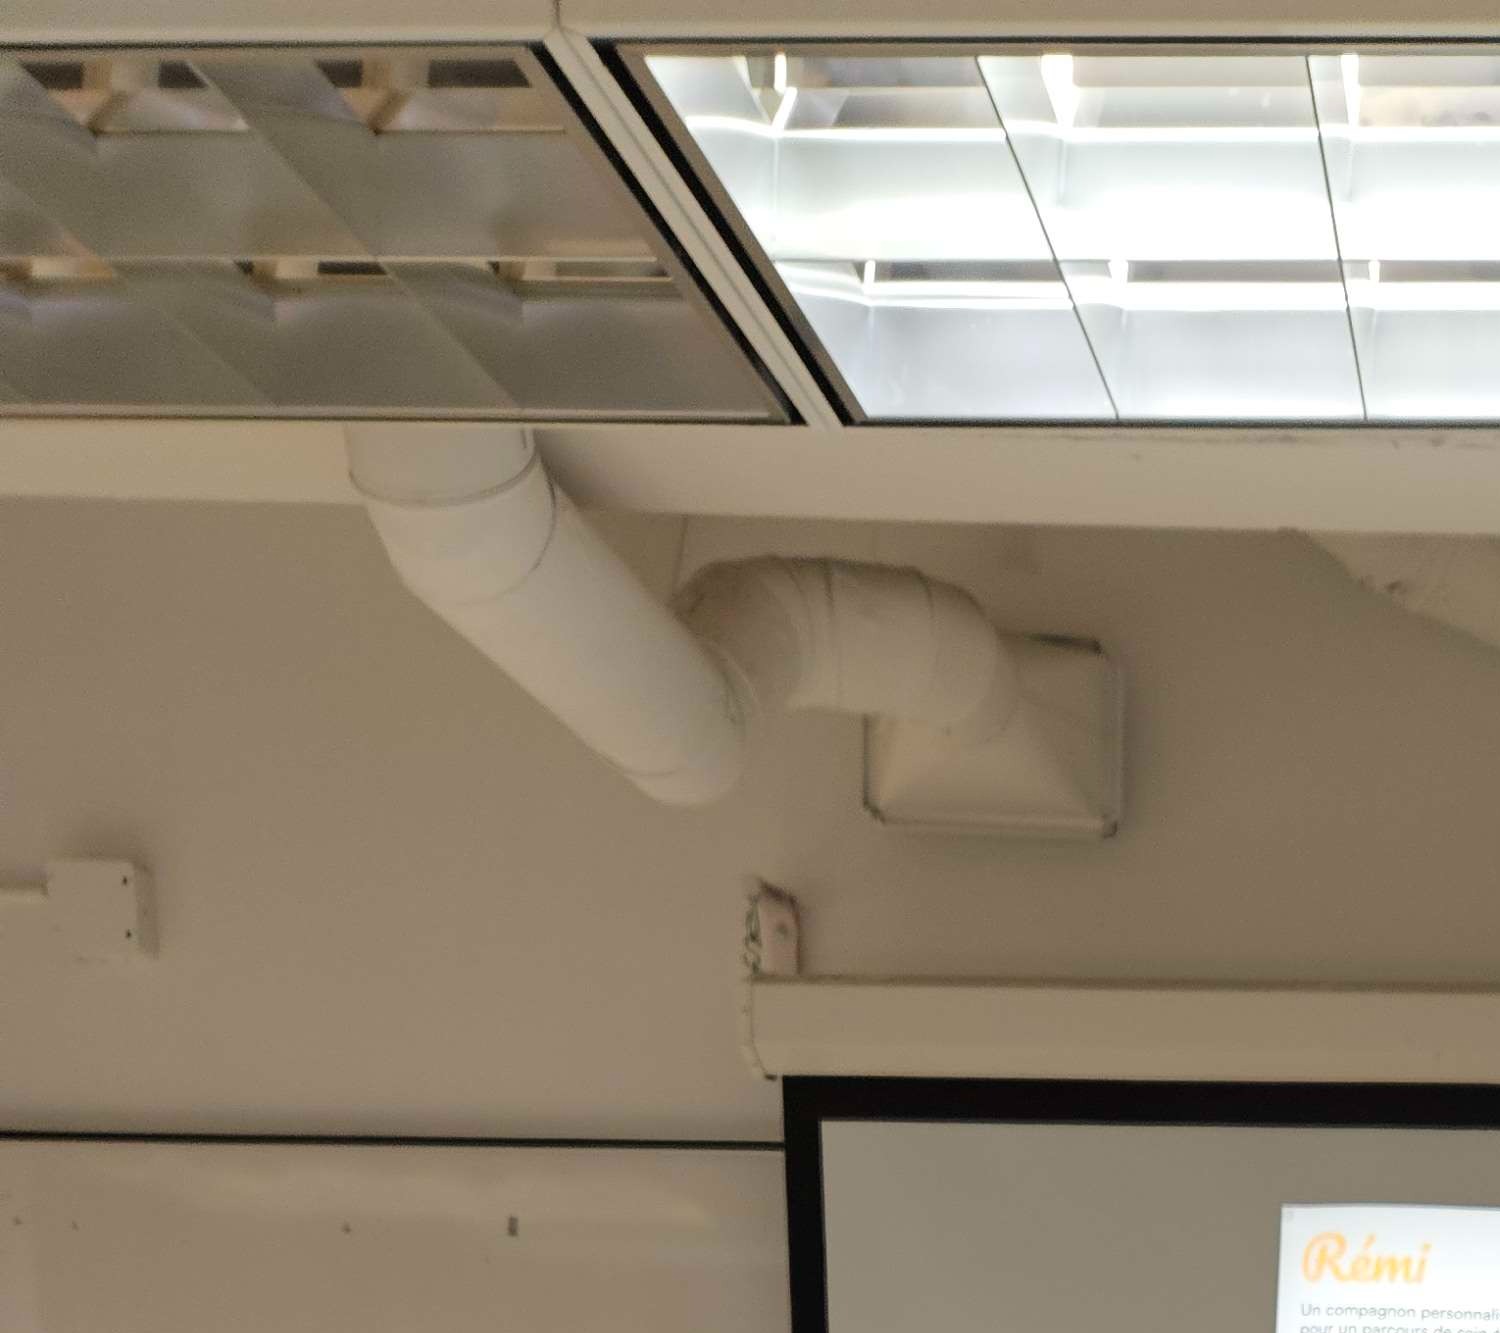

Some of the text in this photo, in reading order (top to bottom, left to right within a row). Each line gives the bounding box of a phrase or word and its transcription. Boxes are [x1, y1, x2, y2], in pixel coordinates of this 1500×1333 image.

[1301, 1231, 1432, 1283] Rémi
[1300, 1303, 1321, 1317] Un
[1325, 1306, 1416, 1321] compagnon
